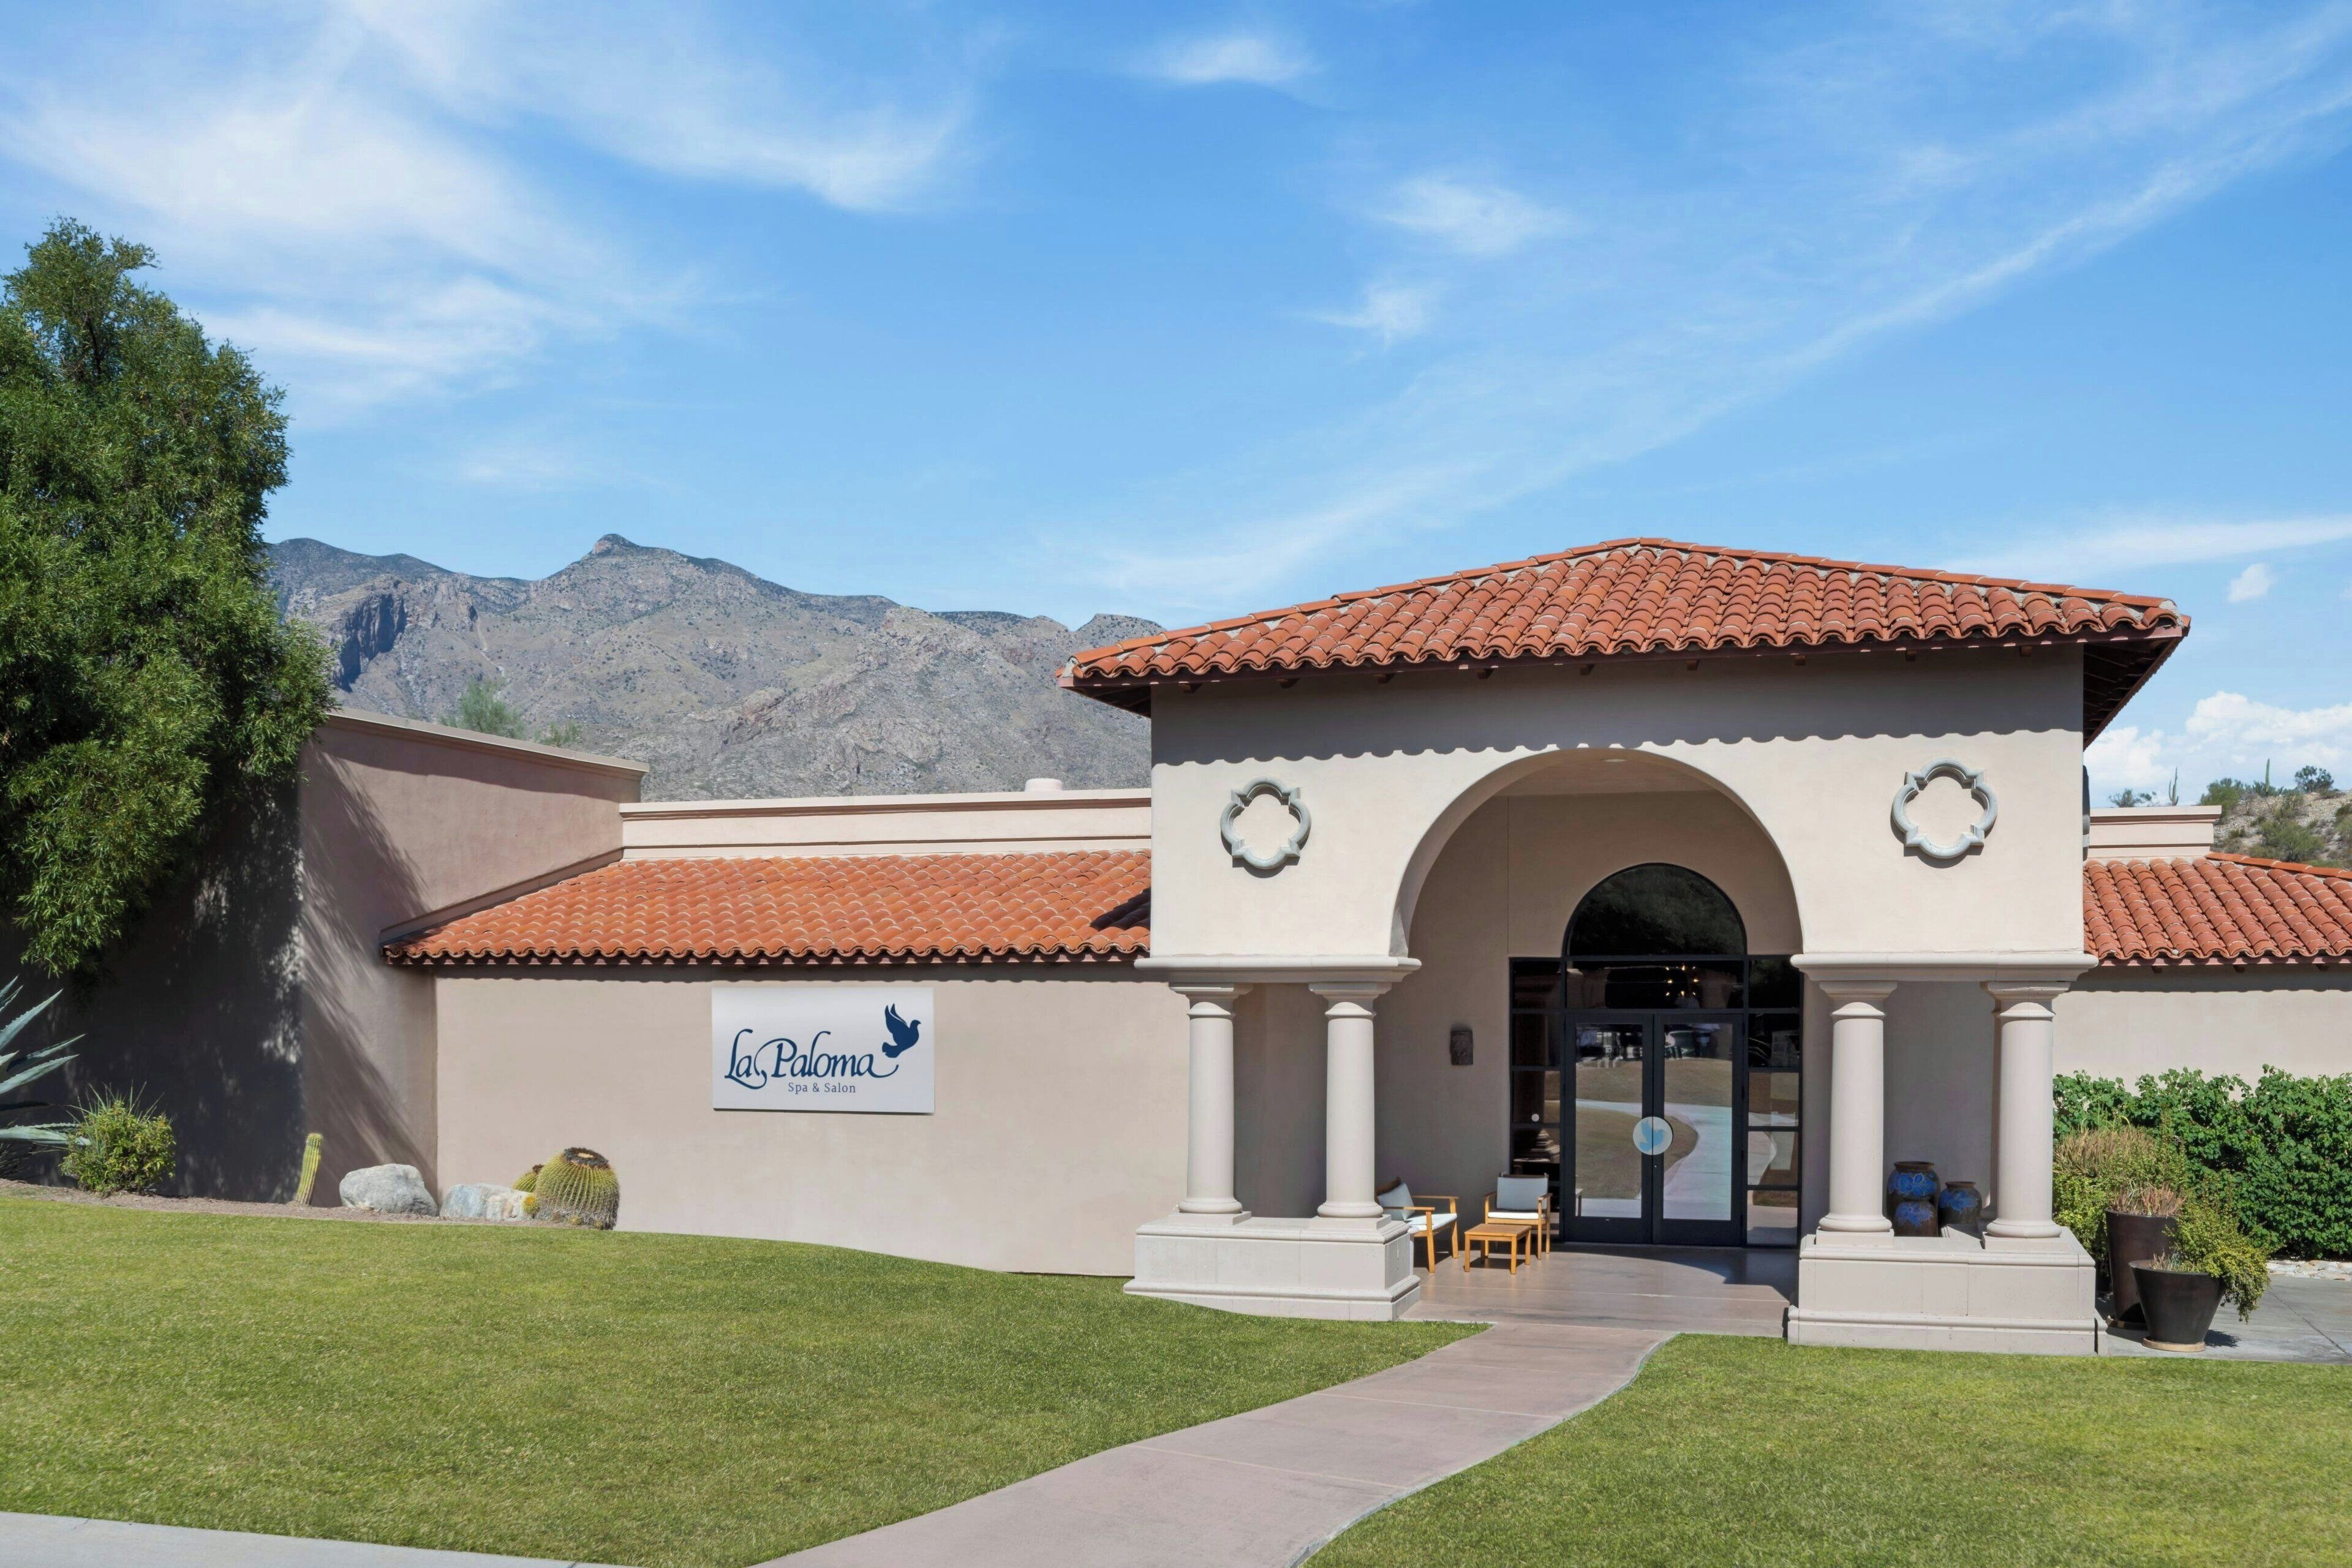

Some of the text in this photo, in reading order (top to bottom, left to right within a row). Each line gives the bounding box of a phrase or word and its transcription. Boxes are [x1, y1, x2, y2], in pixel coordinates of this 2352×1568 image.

[725, 1029, 899, 1090] La Paloma
[788, 1082, 856, 1095] Spa & Salon
